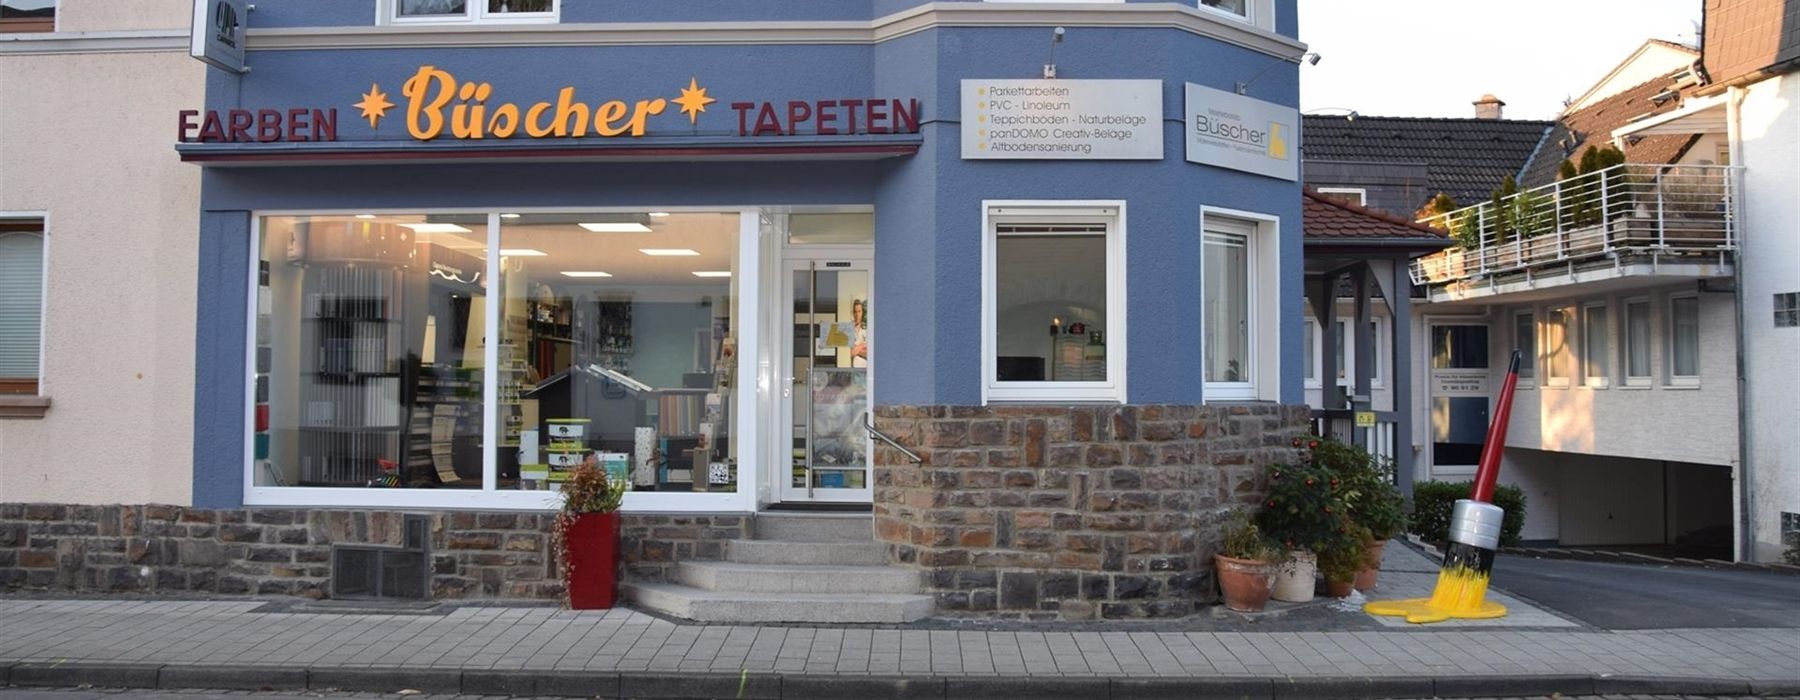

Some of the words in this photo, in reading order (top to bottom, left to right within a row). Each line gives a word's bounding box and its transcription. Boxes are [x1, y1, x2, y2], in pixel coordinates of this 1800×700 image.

[989, 86, 1070, 97] Parkettarbeiten
[178, 107, 338, 142] FARBEN
[402, 65, 667, 140] Büscher
[731, 97, 921, 137] TAPETEN
[989, 100, 1012, 110] PVC
[1022, 100, 1071, 110] Linoleum
[989, 128, 1049, 139] panDOMO
[1196, 114, 1267, 144] Büscher
[991, 142, 1092, 154] Altbodensanierung
